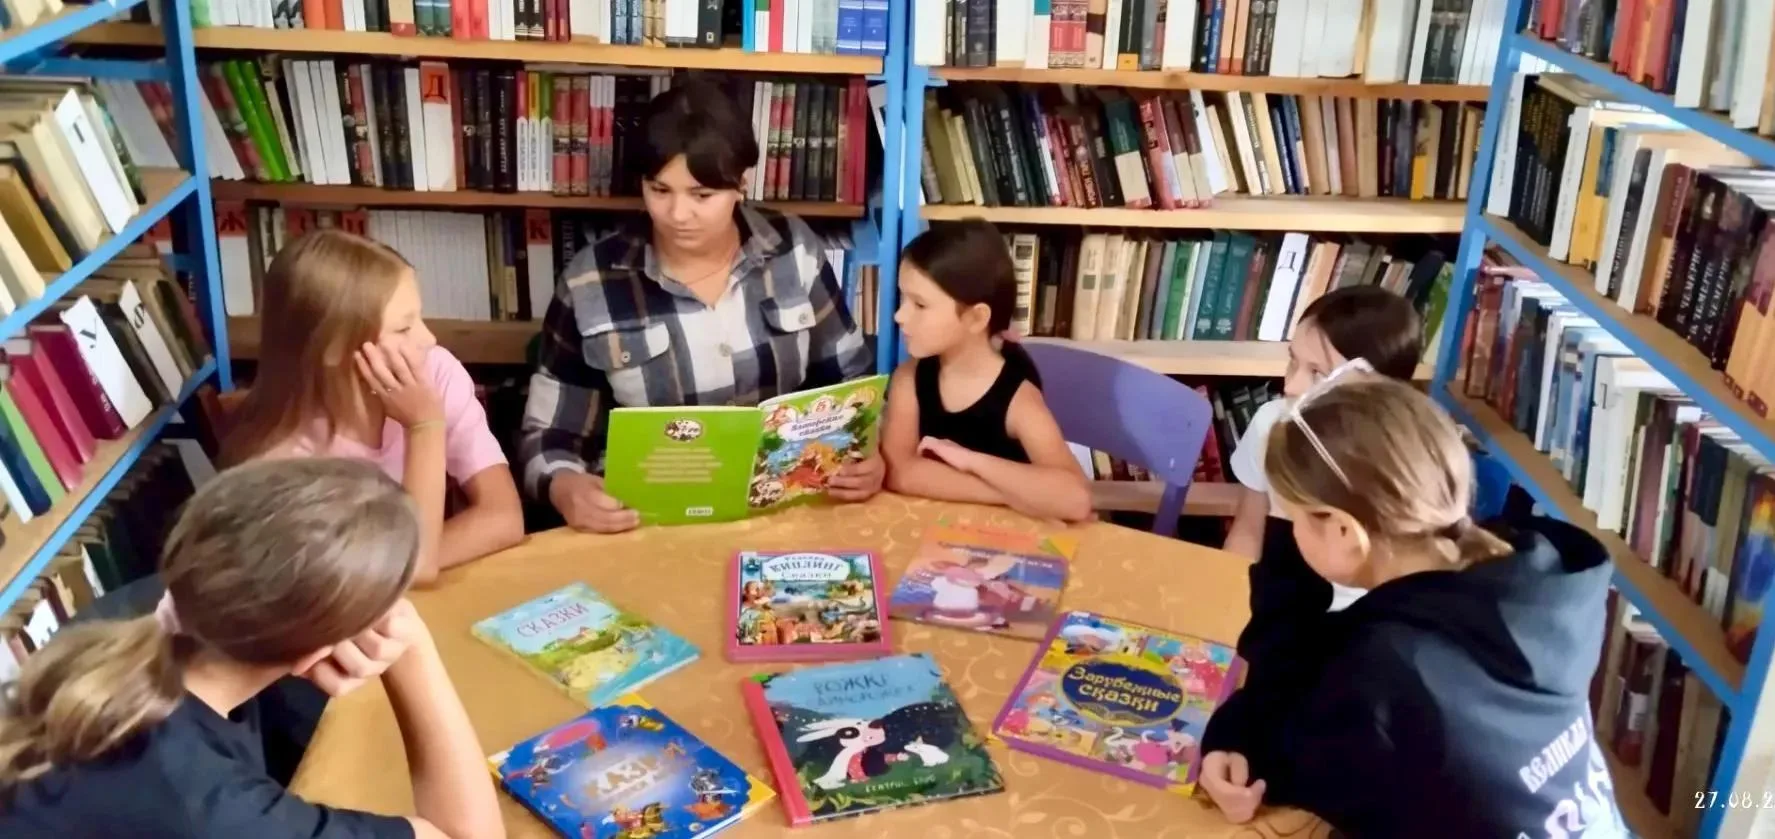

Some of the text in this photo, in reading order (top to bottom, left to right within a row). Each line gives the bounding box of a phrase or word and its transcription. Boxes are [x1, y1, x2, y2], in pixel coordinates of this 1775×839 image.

[424, 74, 447, 100] Д
[529, 219, 549, 240] К
[1278, 251, 1297, 272] Д
[133, 303, 145, 329] Ф
[79, 316, 98, 350] У
[768, 559, 843, 573] КИПЛИНГ
[516, 602, 589, 638] СКАЗКИ
[1067, 666, 1181, 702] Зарубежные
